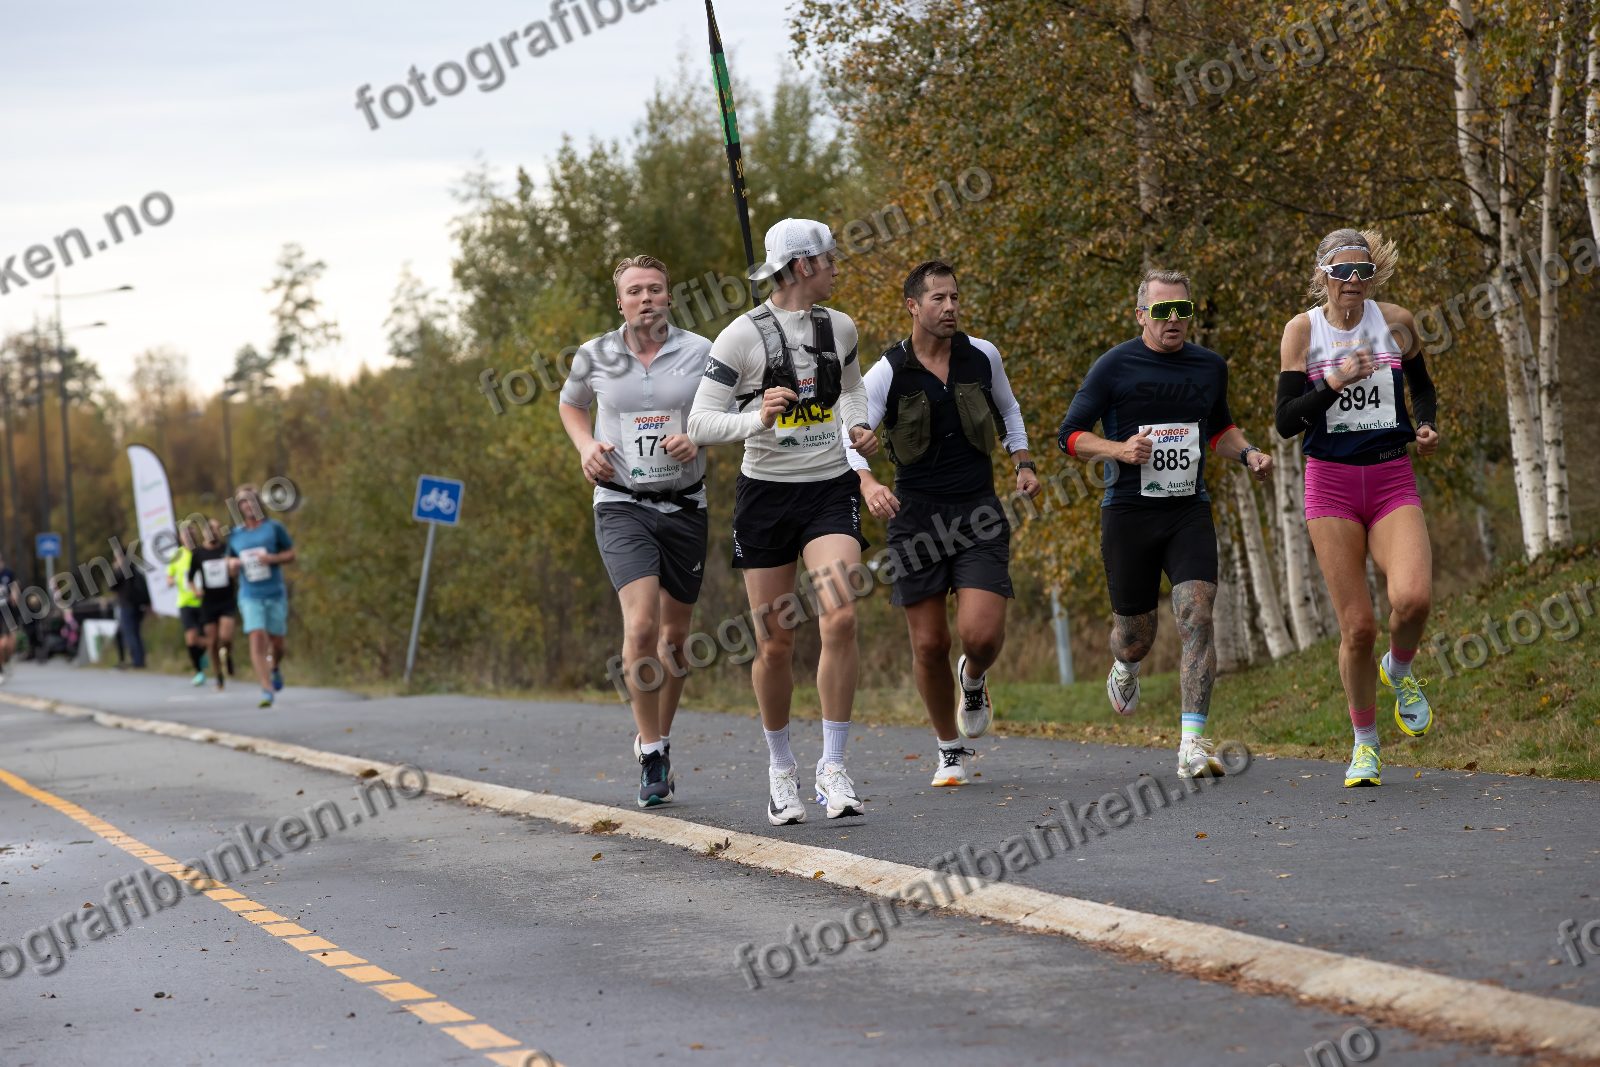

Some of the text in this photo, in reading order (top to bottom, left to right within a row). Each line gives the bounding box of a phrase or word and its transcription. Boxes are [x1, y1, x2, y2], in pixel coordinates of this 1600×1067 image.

[1339, 385, 1381, 412] 894
[634, 415, 670, 424] NORGES
[1356, 419, 1394, 431] Aurskog
[638, 422, 665, 431] LØPET
[803, 431, 836, 442] Aurskog
[1154, 428, 1189, 437] NORGES
[1158, 435, 1184, 444] LØPET
[634, 434, 667, 457] 171
[1152, 448, 1190, 471] 885
[648, 463, 680, 474] Aurskog
